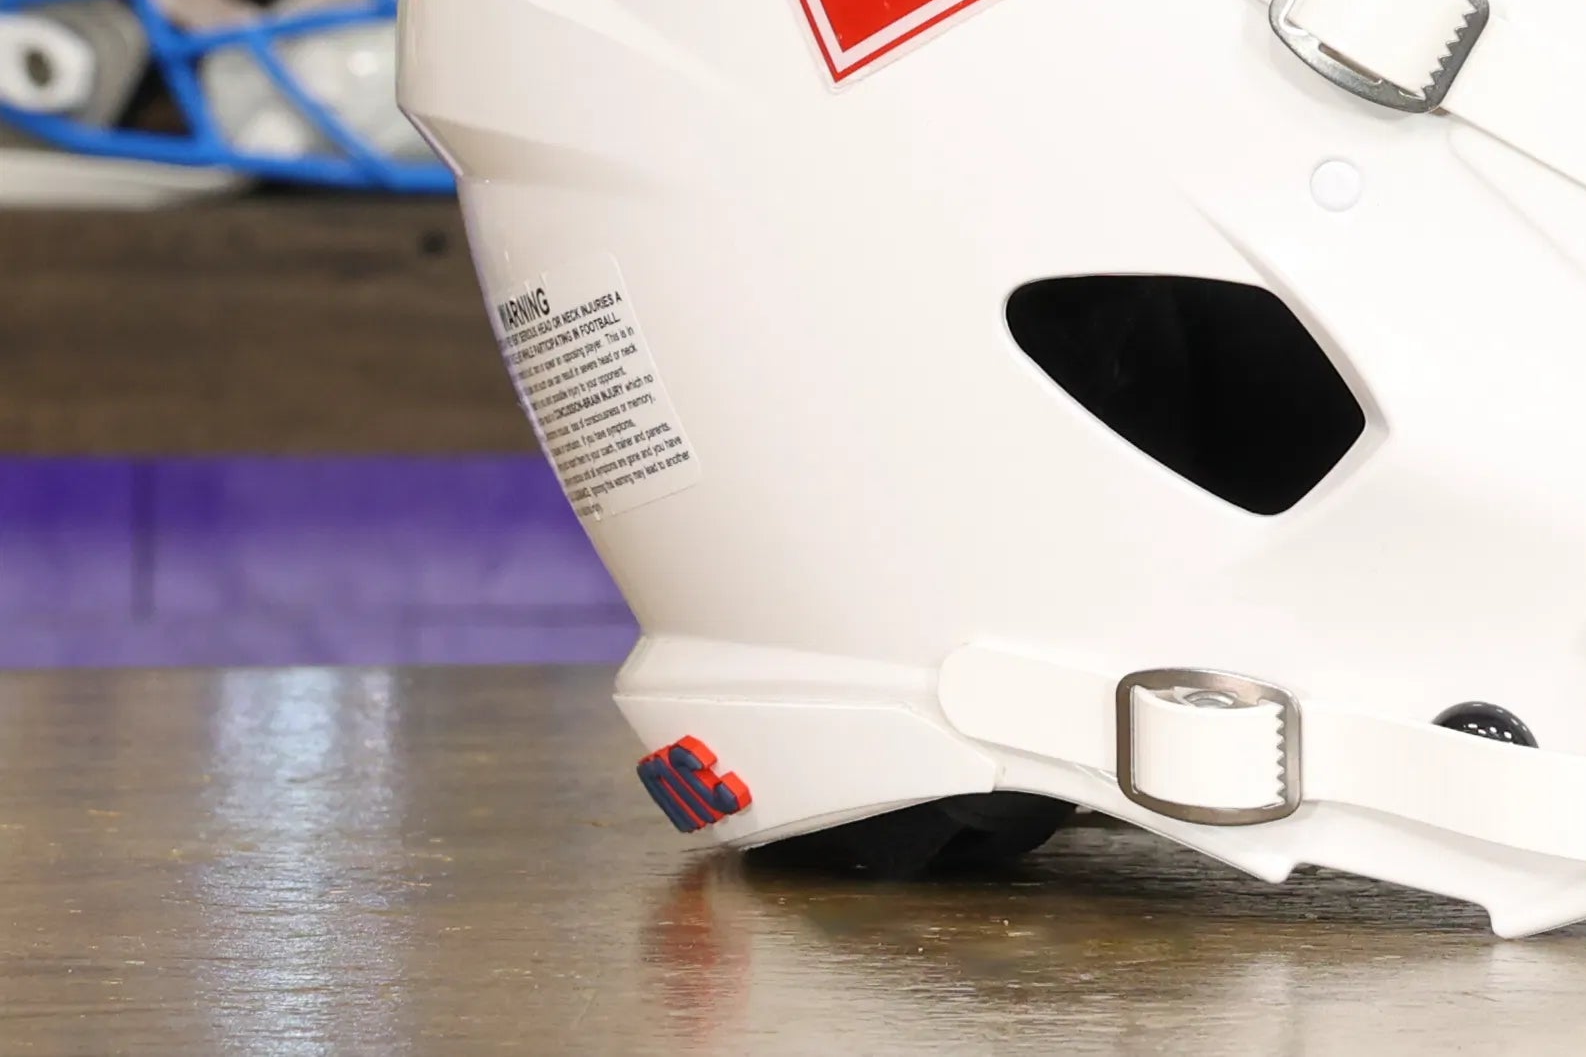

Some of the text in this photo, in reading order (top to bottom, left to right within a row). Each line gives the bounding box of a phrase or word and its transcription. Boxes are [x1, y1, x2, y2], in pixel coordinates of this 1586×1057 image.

[498, 288, 551, 332] WARNING
[561, 308, 581, 324] NECK
[580, 294, 614, 316] INJURIES
[615, 291, 622, 303] A
[604, 332, 620, 344] This
[619, 329, 627, 339] is
[625, 325, 635, 337] in
[597, 352, 614, 366] head
[613, 350, 620, 360] or
[620, 342, 638, 358] neck
[600, 384, 624, 402] INJURY
[625, 376, 644, 392] which
[643, 374, 654, 385] no
[633, 431, 646, 444] and
[640, 447, 653, 460] and
[652, 443, 665, 457] you
[664, 436, 682, 450] have
[644, 462, 658, 475] lead
[657, 460, 666, 471] to
[665, 450, 690, 468] another
